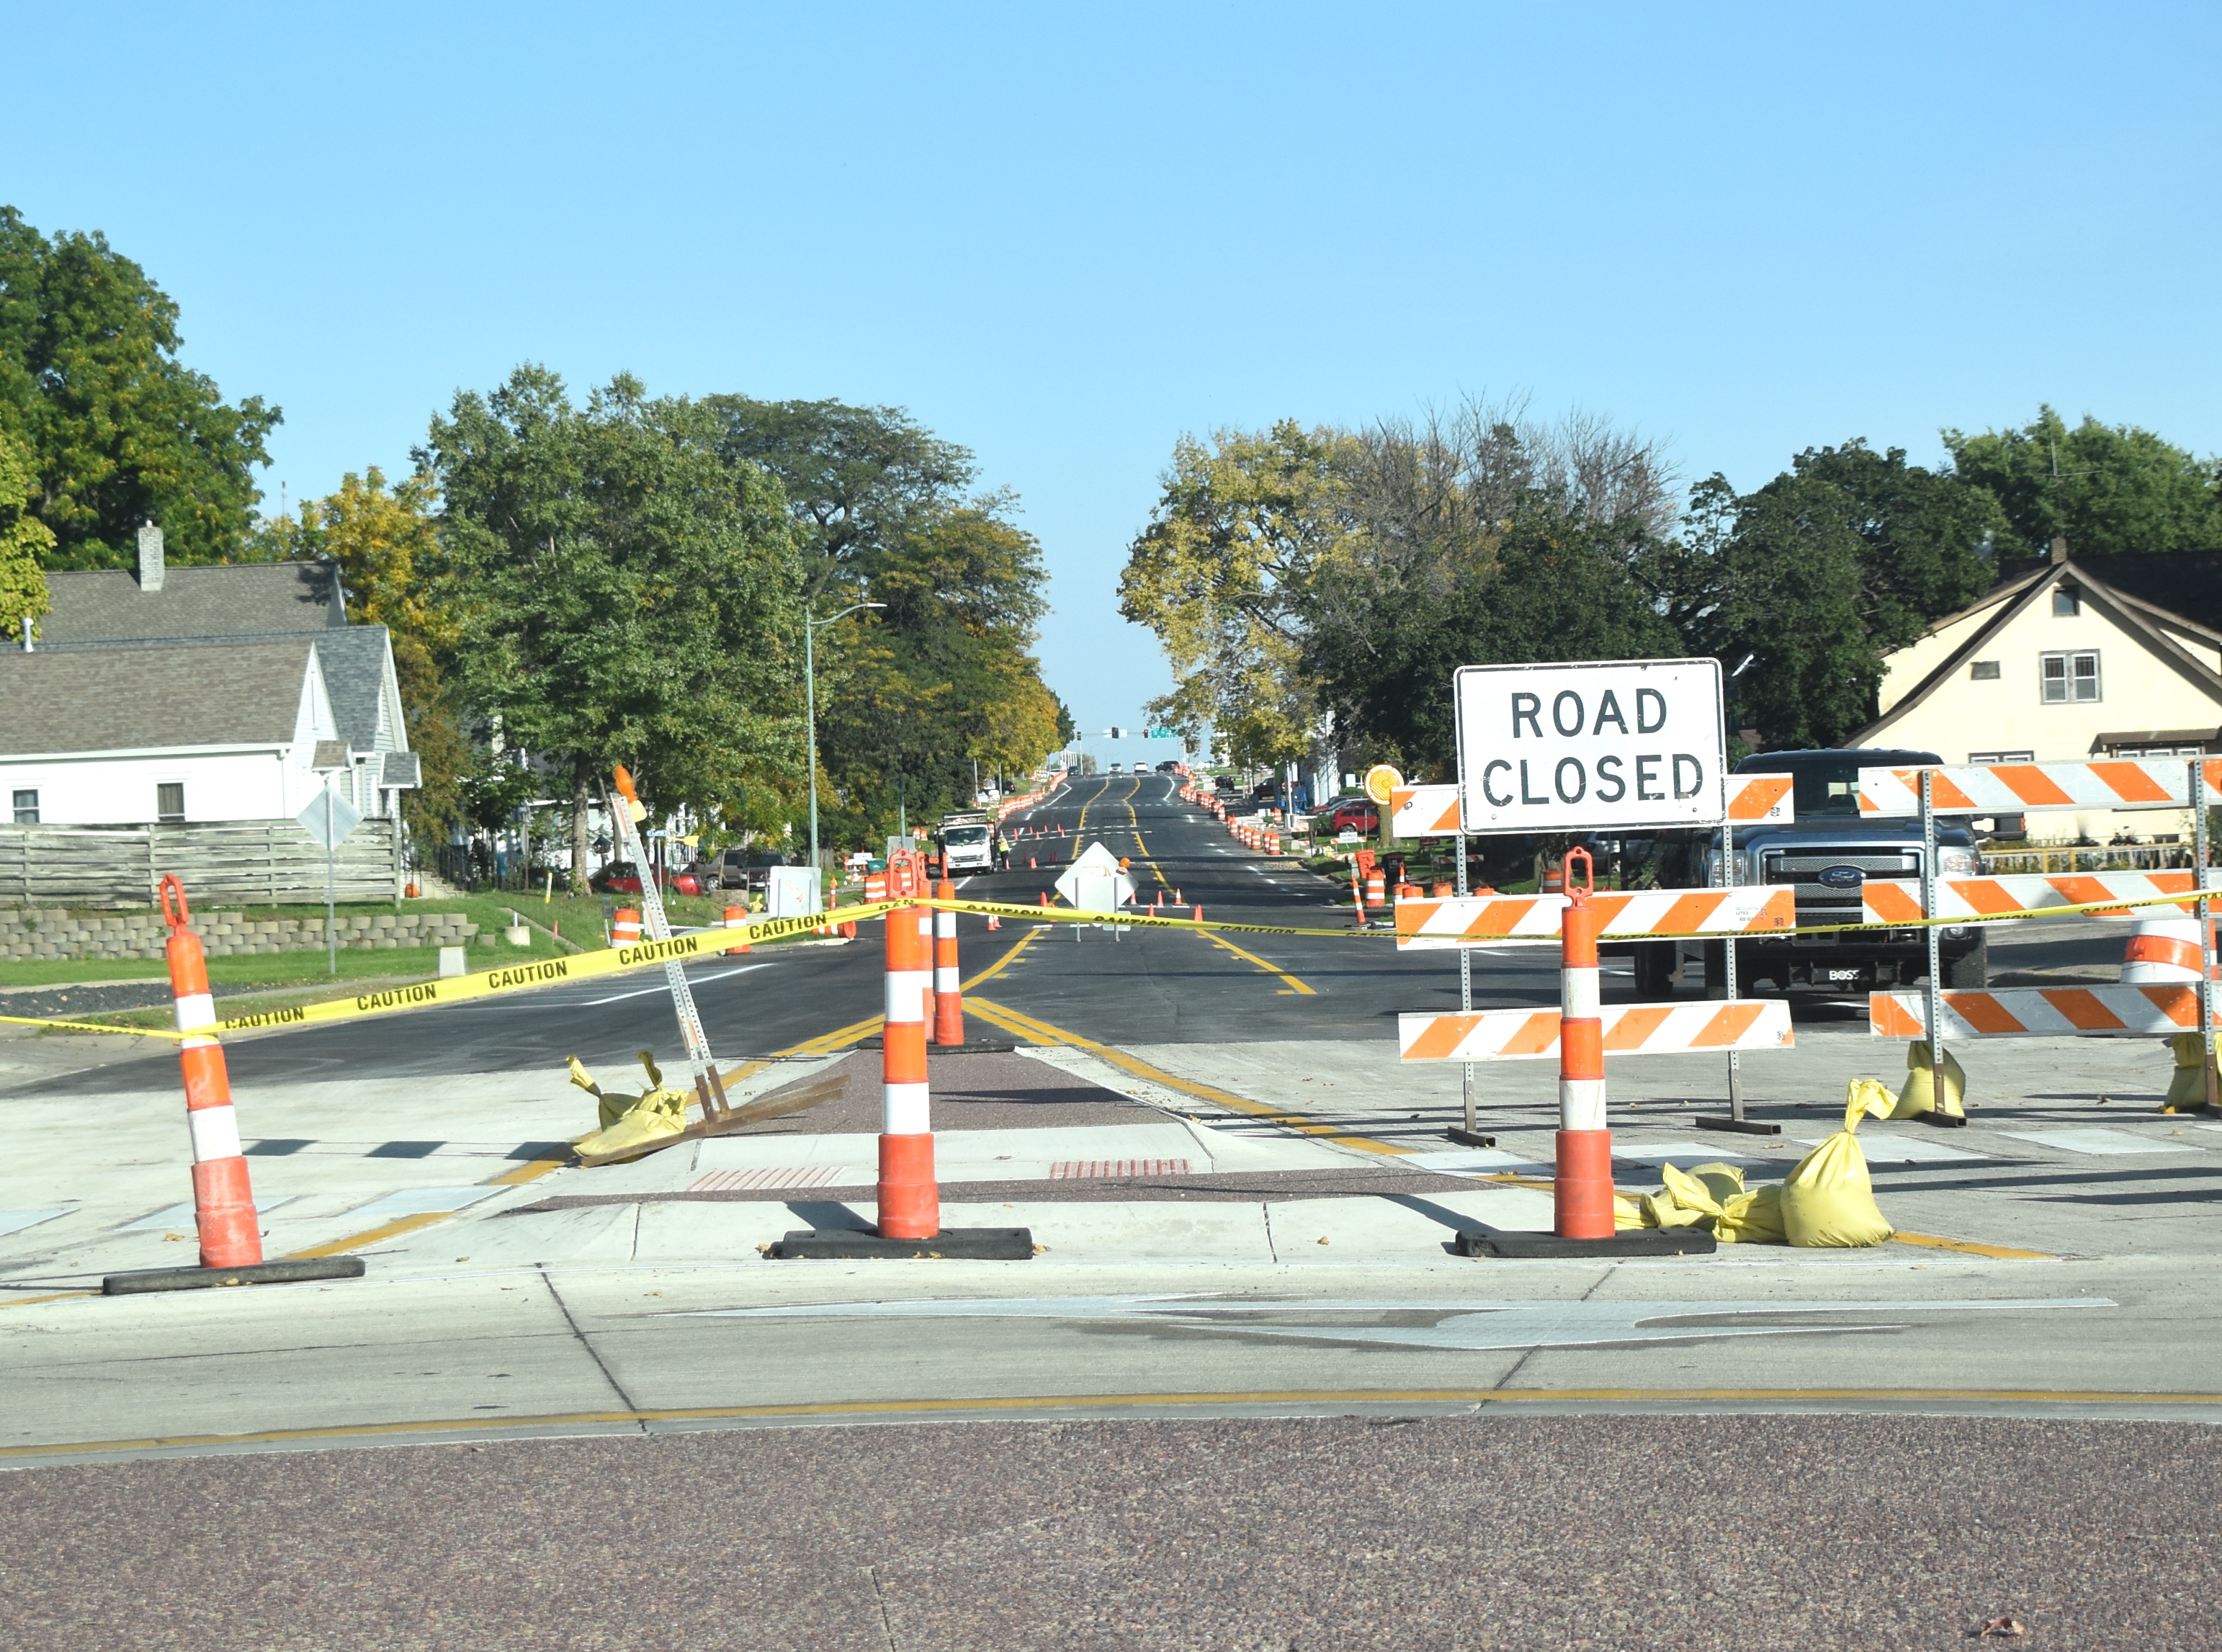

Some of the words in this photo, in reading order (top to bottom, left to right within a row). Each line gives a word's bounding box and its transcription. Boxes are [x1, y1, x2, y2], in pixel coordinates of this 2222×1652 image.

[1511, 688, 1667, 738] ROAD
[1483, 753, 1703, 807] CLOSED
[749, 914, 827, 939] CAUTION
[1093, 915, 1170, 927] CAUTION
[1219, 925, 1297, 934] CAUTION
[619, 936, 699, 965] CAUTION
[488, 961, 568, 989] CAUTION
[1829, 969, 1860, 980] BOSS
[357, 984, 437, 1010] CAUTION
[225, 1007, 305, 1029] CAUTION
